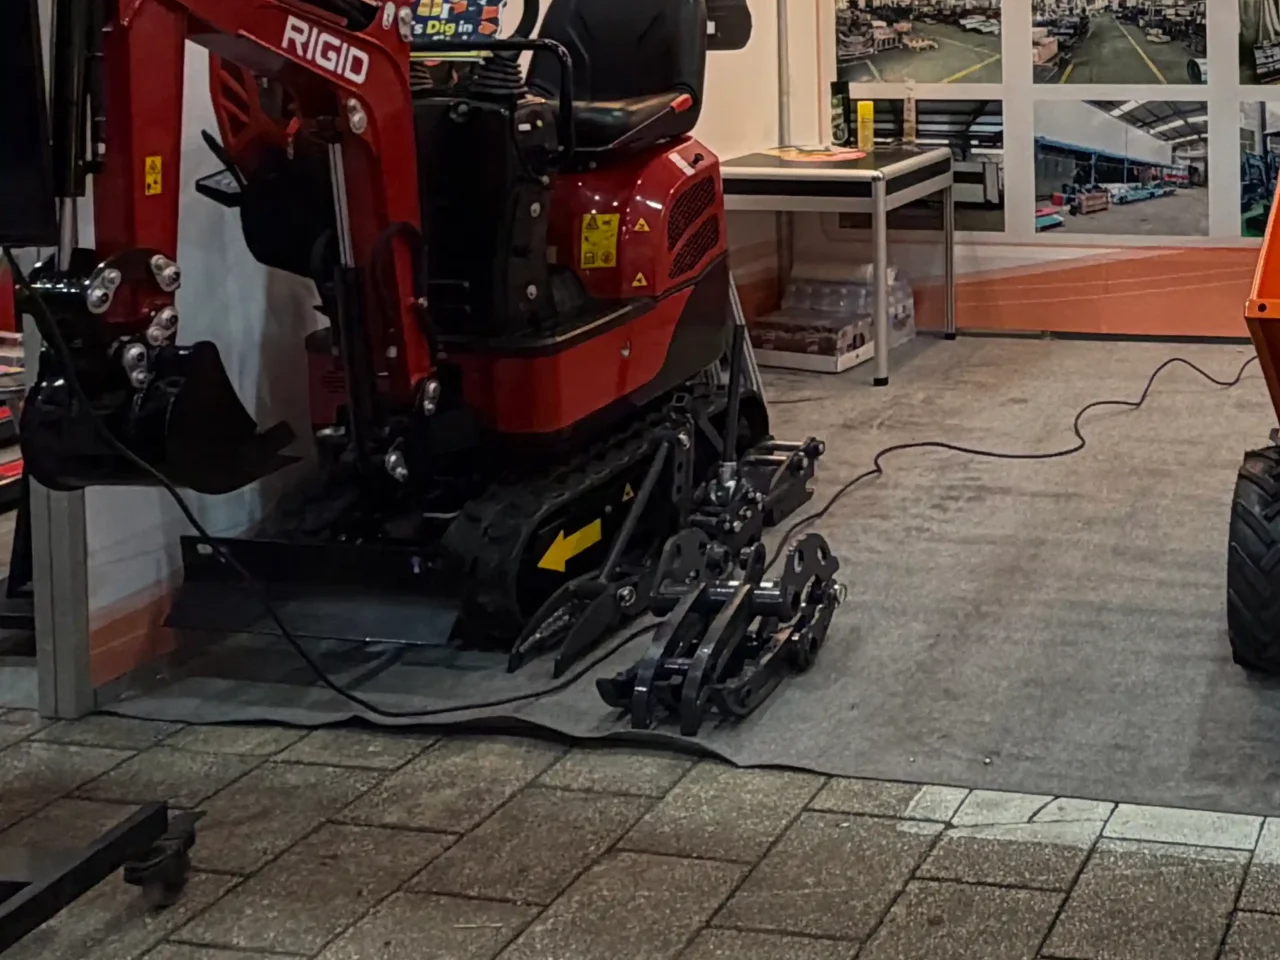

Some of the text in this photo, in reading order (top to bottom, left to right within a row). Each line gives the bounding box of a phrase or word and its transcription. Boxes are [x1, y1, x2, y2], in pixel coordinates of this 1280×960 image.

[281, 14, 370, 85] RIGID
[426, 20, 456, 36] Dig
[458, 20, 473, 33] in
